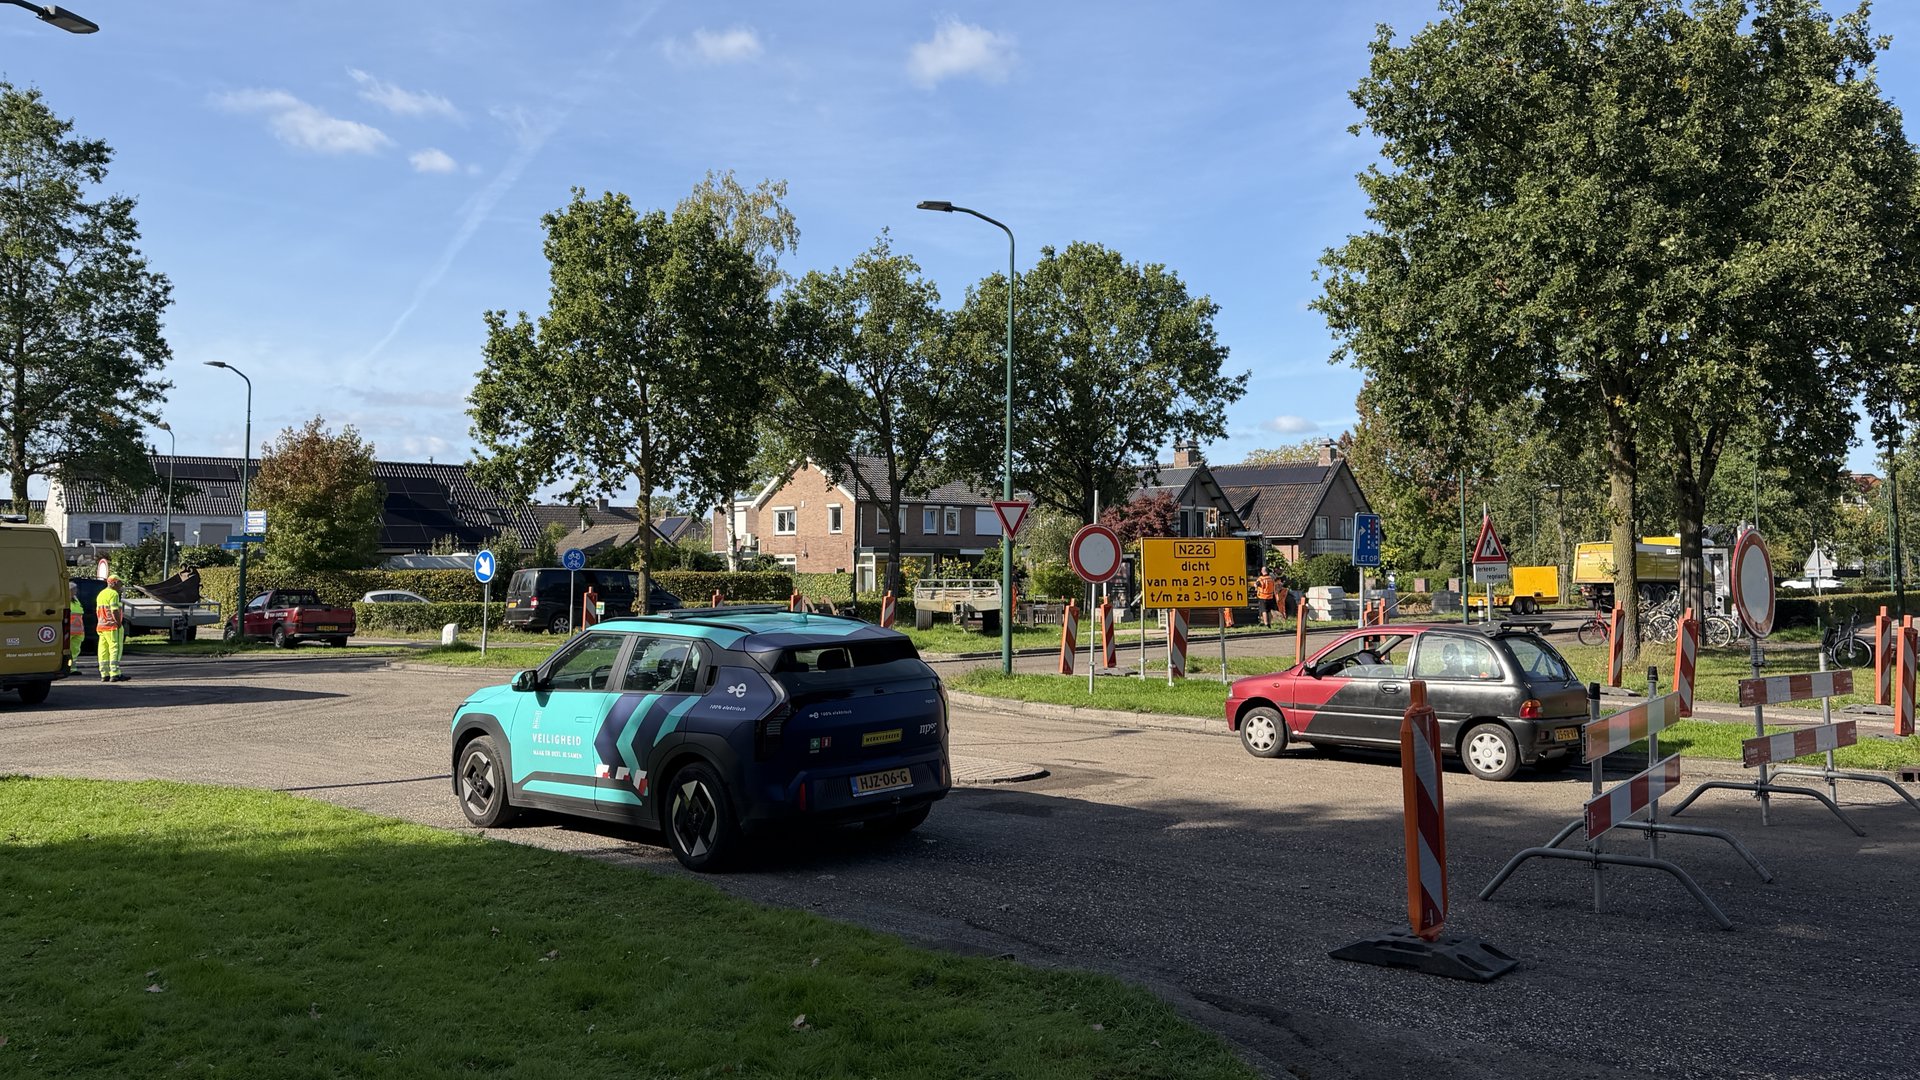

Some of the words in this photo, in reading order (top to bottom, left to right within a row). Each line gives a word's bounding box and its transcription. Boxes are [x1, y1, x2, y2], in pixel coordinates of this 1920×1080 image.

[1178, 544, 1211, 555] N226
[1181, 561, 1210, 571] dicht
[1147, 579, 1167, 587] van
[1171, 579, 1189, 587] ma
[1192, 576, 1217, 586] 21-9
[1220, 576, 1235, 586] 05
[1239, 576, 1246, 586] h
[1150, 591, 1173, 603] t/m
[1176, 593, 1190, 602] za
[1194, 591, 1219, 601] 3-10
[1221, 591, 1233, 601] 16
[1236, 591, 1243, 601] h
[532, 733, 582, 746] VEILIGHEID
[865, 733, 900, 742] WERKVERKEER
[861, 770, 908, 790] HJZ-06-G
